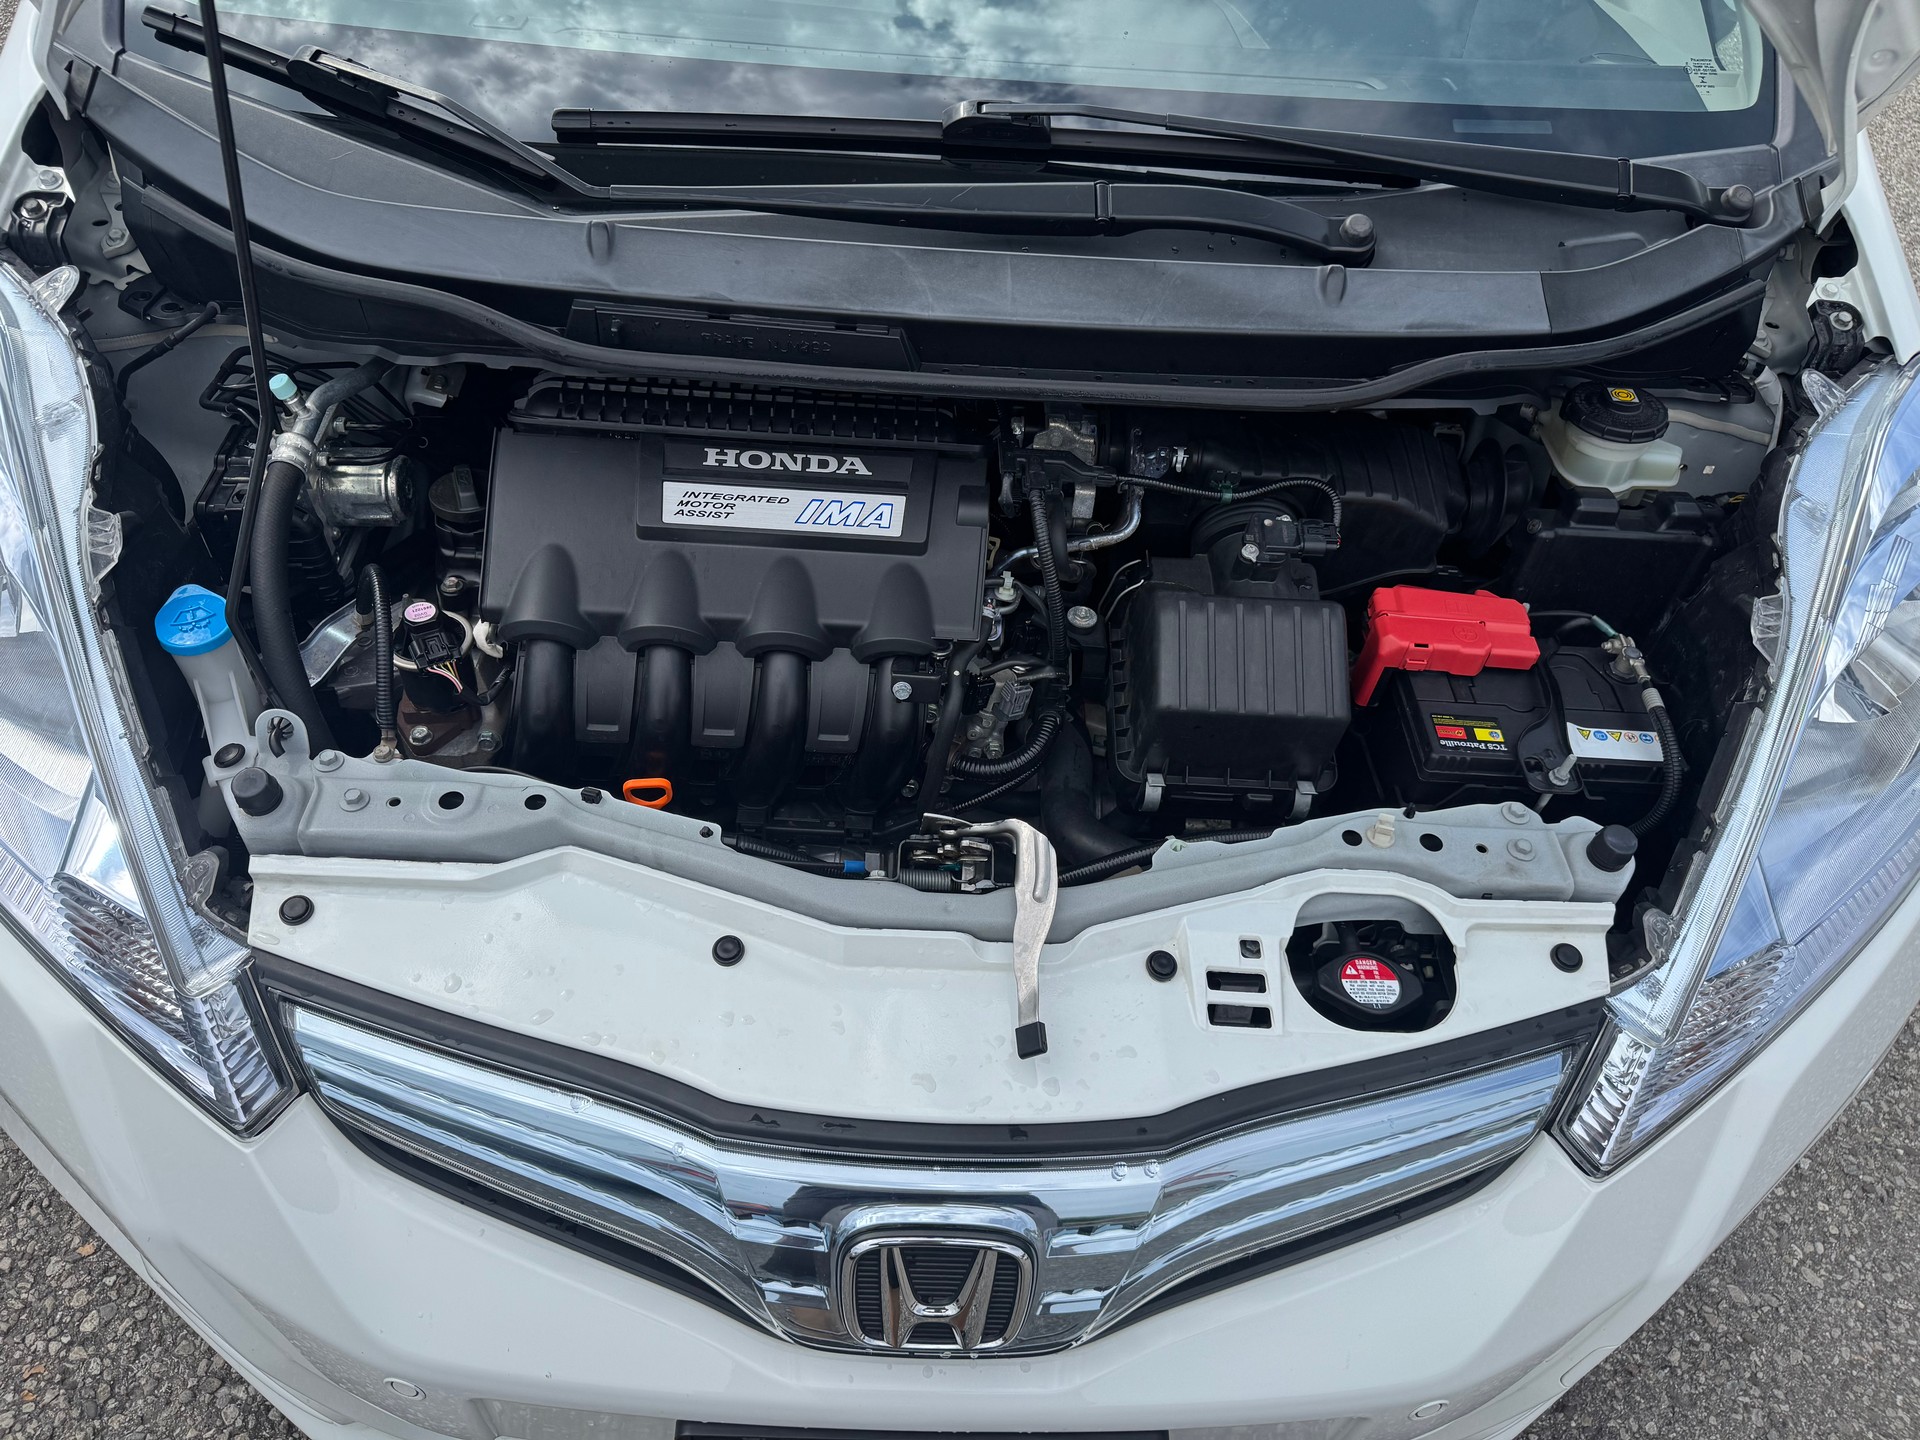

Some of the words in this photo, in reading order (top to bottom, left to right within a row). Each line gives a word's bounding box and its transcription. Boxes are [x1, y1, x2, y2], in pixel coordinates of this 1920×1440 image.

[702, 447, 873, 476] HONDA
[682, 491, 790, 504] INTEGRATED
[676, 500, 736, 510] MOTOR
[673, 509, 735, 519] ASSIST
[794, 498, 894, 529] IMA
[1440, 740, 1486, 750] Patrouille
[1487, 743, 1508, 751] TCS
